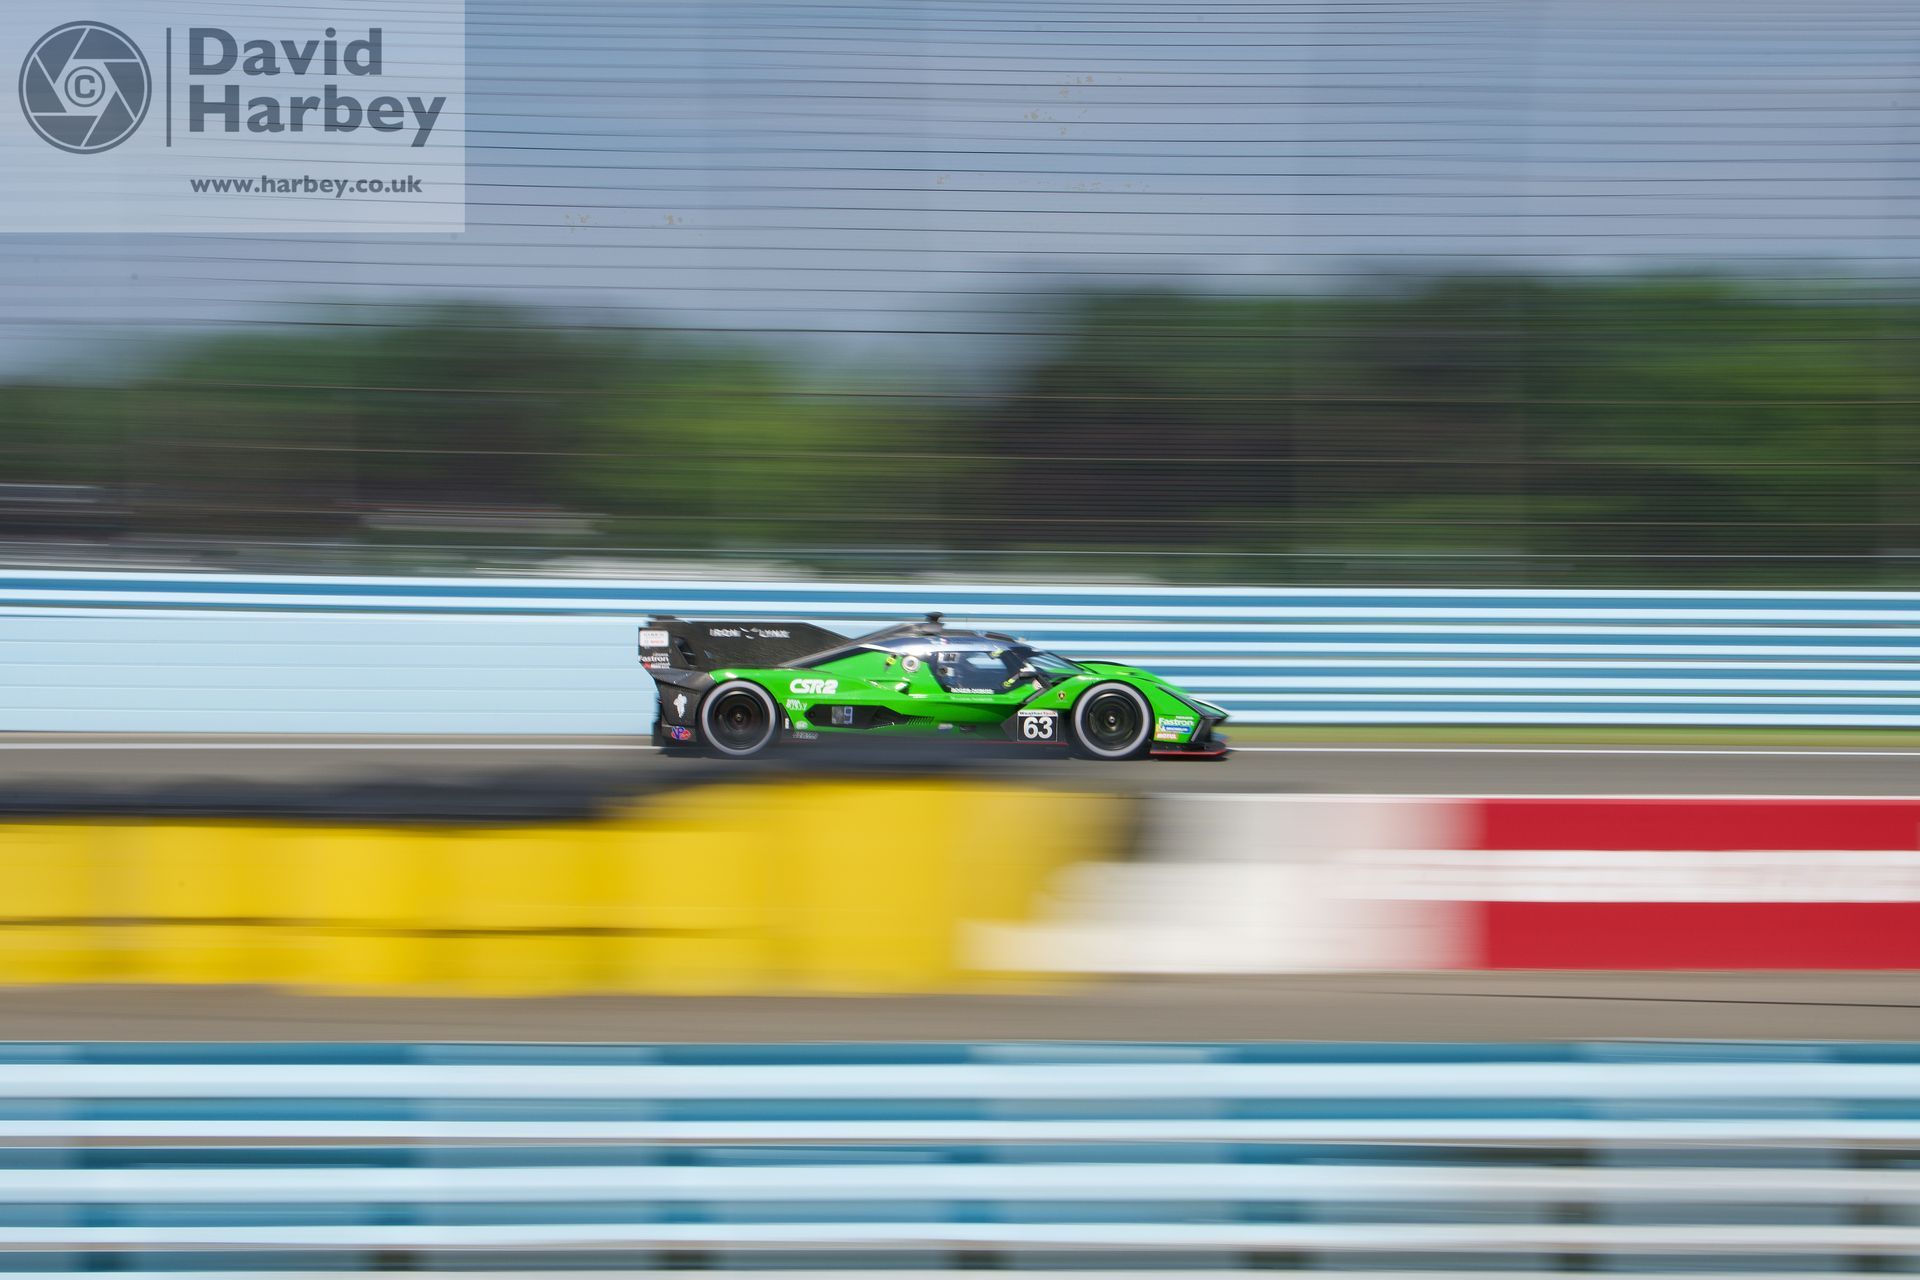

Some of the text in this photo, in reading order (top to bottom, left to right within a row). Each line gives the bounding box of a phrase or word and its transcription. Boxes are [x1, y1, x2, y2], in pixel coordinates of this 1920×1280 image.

[789, 678, 839, 695] CSR2
[1023, 716, 1053, 739] 63
[1158, 717, 1194, 727] Fastron
